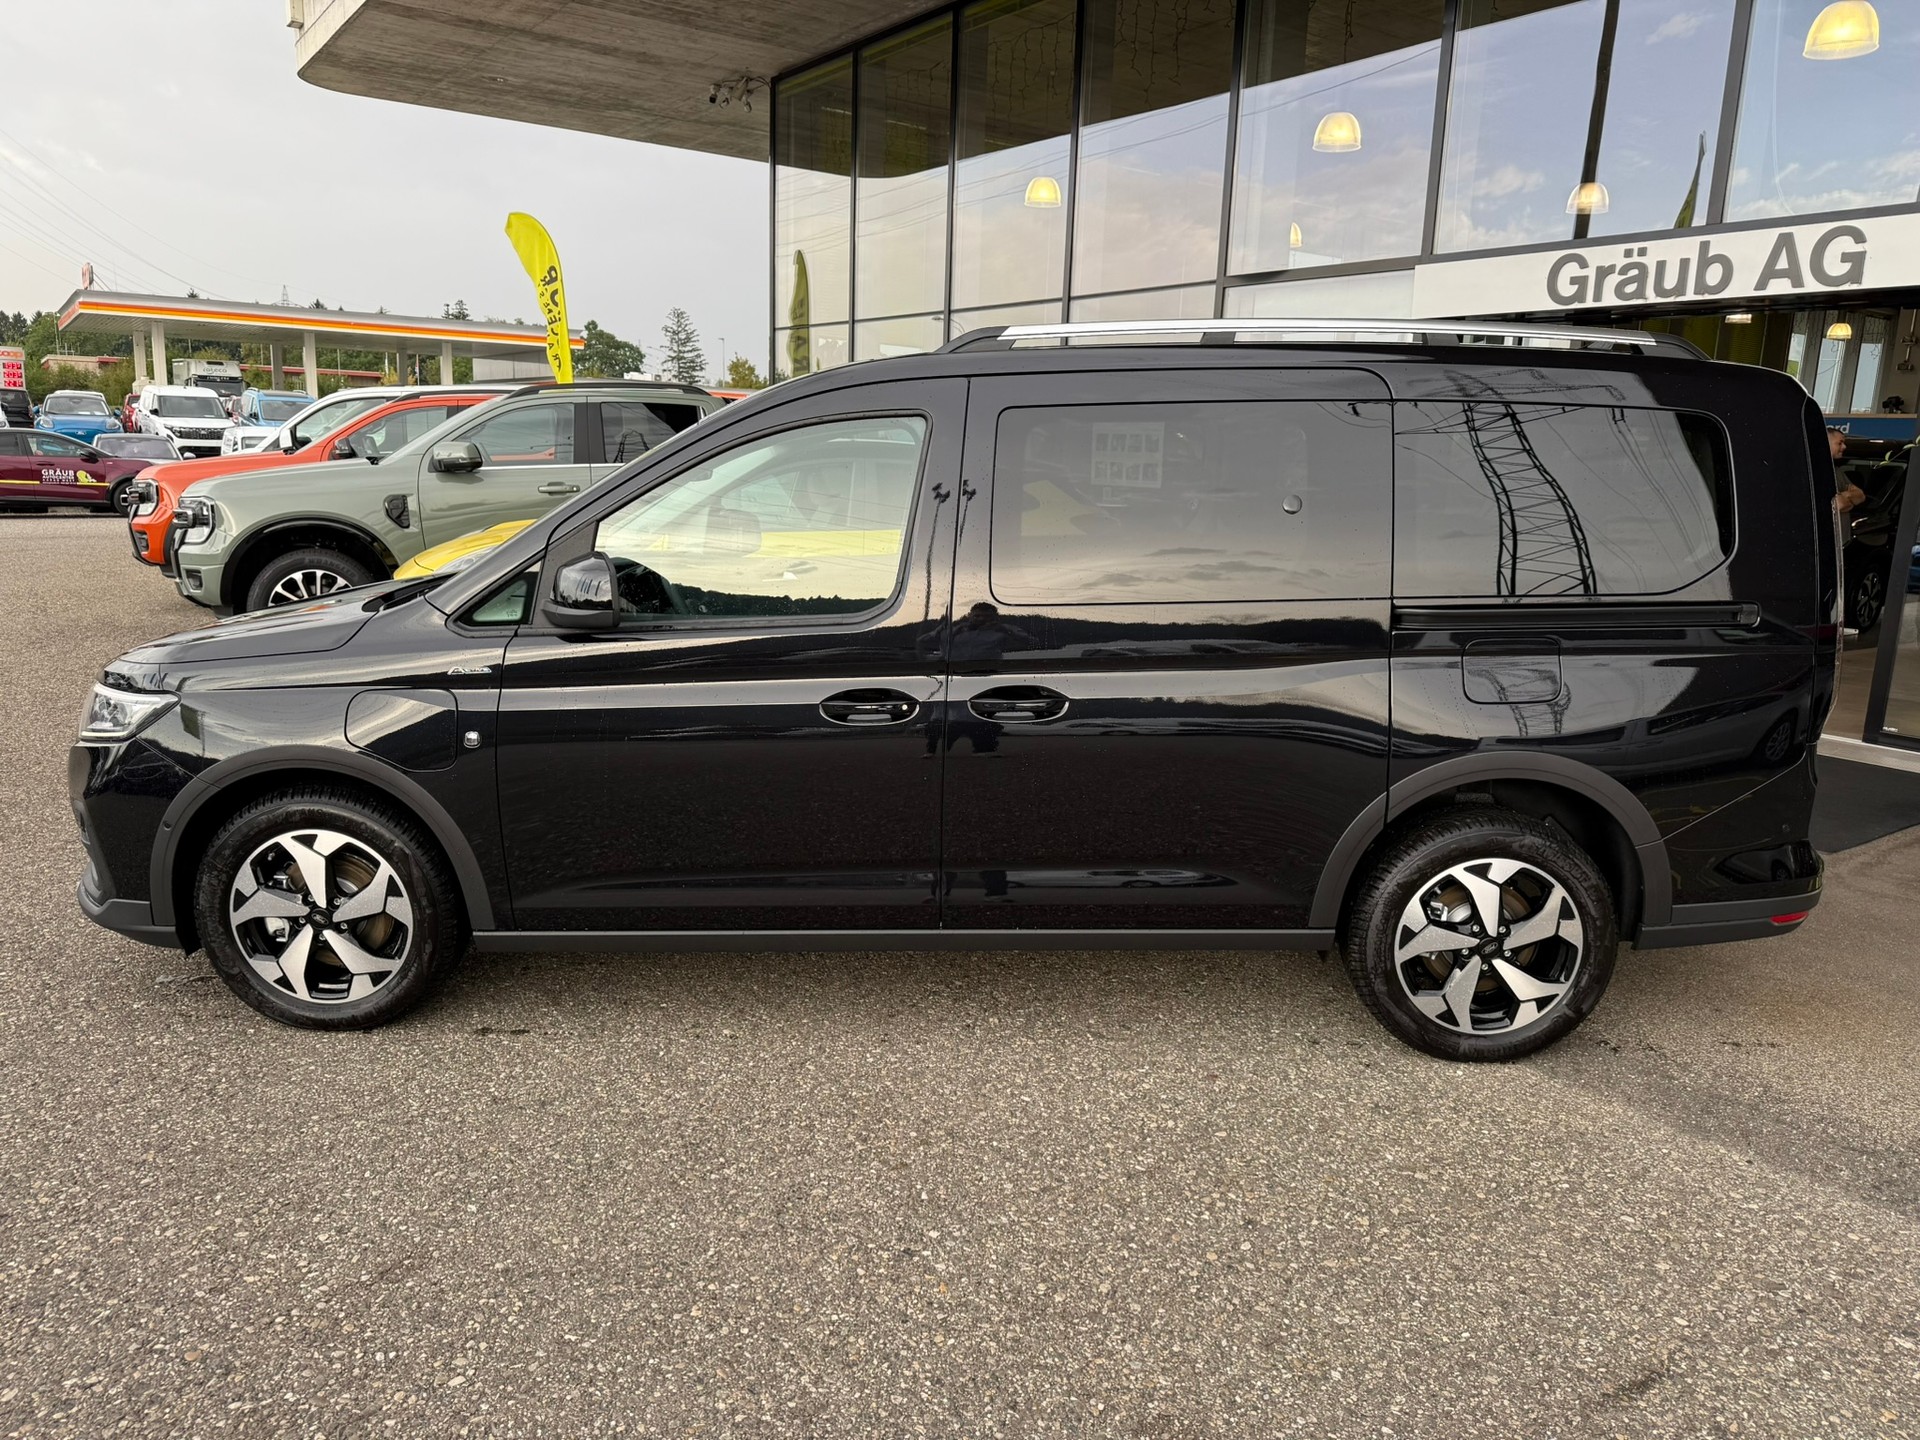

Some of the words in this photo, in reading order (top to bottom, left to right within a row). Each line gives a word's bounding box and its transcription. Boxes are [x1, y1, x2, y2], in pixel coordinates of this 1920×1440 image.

[1546, 240, 1734, 306] Gräub
[1753, 225, 1867, 291] AG
[41, 468, 75, 476] GRÄUB
